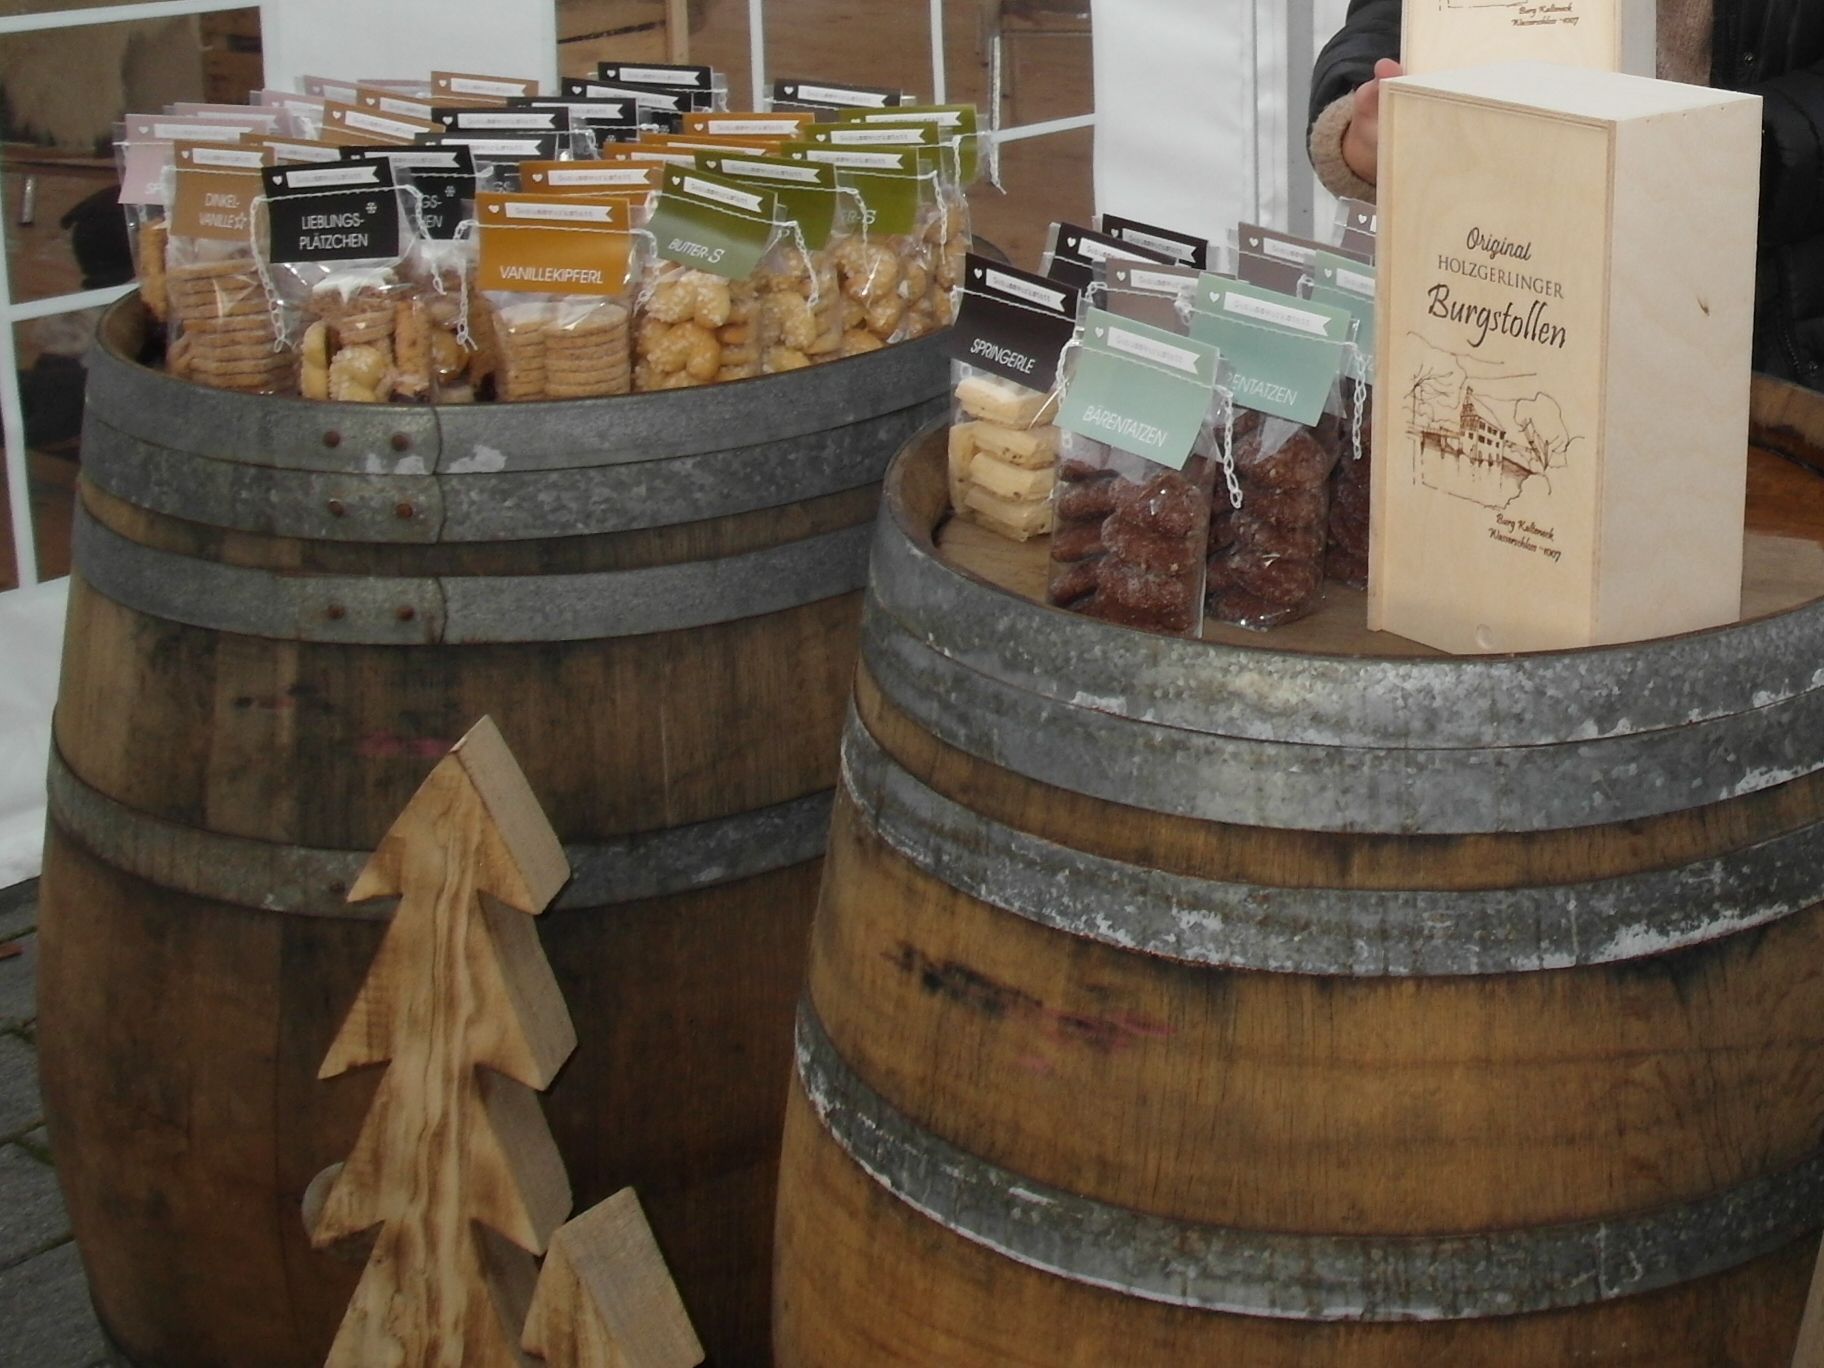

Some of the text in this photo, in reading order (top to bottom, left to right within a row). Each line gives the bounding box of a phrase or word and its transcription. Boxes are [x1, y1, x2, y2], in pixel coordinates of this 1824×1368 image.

[1518, 6, 1537, 18] Burg
[301, 211, 365, 230] LIEBLINGS-
[299, 233, 368, 250] PLÄTZCHEN
[668, 237, 725, 264] BUTTER-S
[1466, 227, 1532, 262] Original
[500, 265, 603, 285] VANILLEKIPFERL
[1438, 255, 1564, 299] HOLZGERLINGER
[1427, 283, 1567, 349] Burgstollen
[970, 338, 1036, 375] SPRINGERLE
[1082, 404, 1168, 448] BÄRENTATZEN
[1496, 513, 1516, 533] Burg
